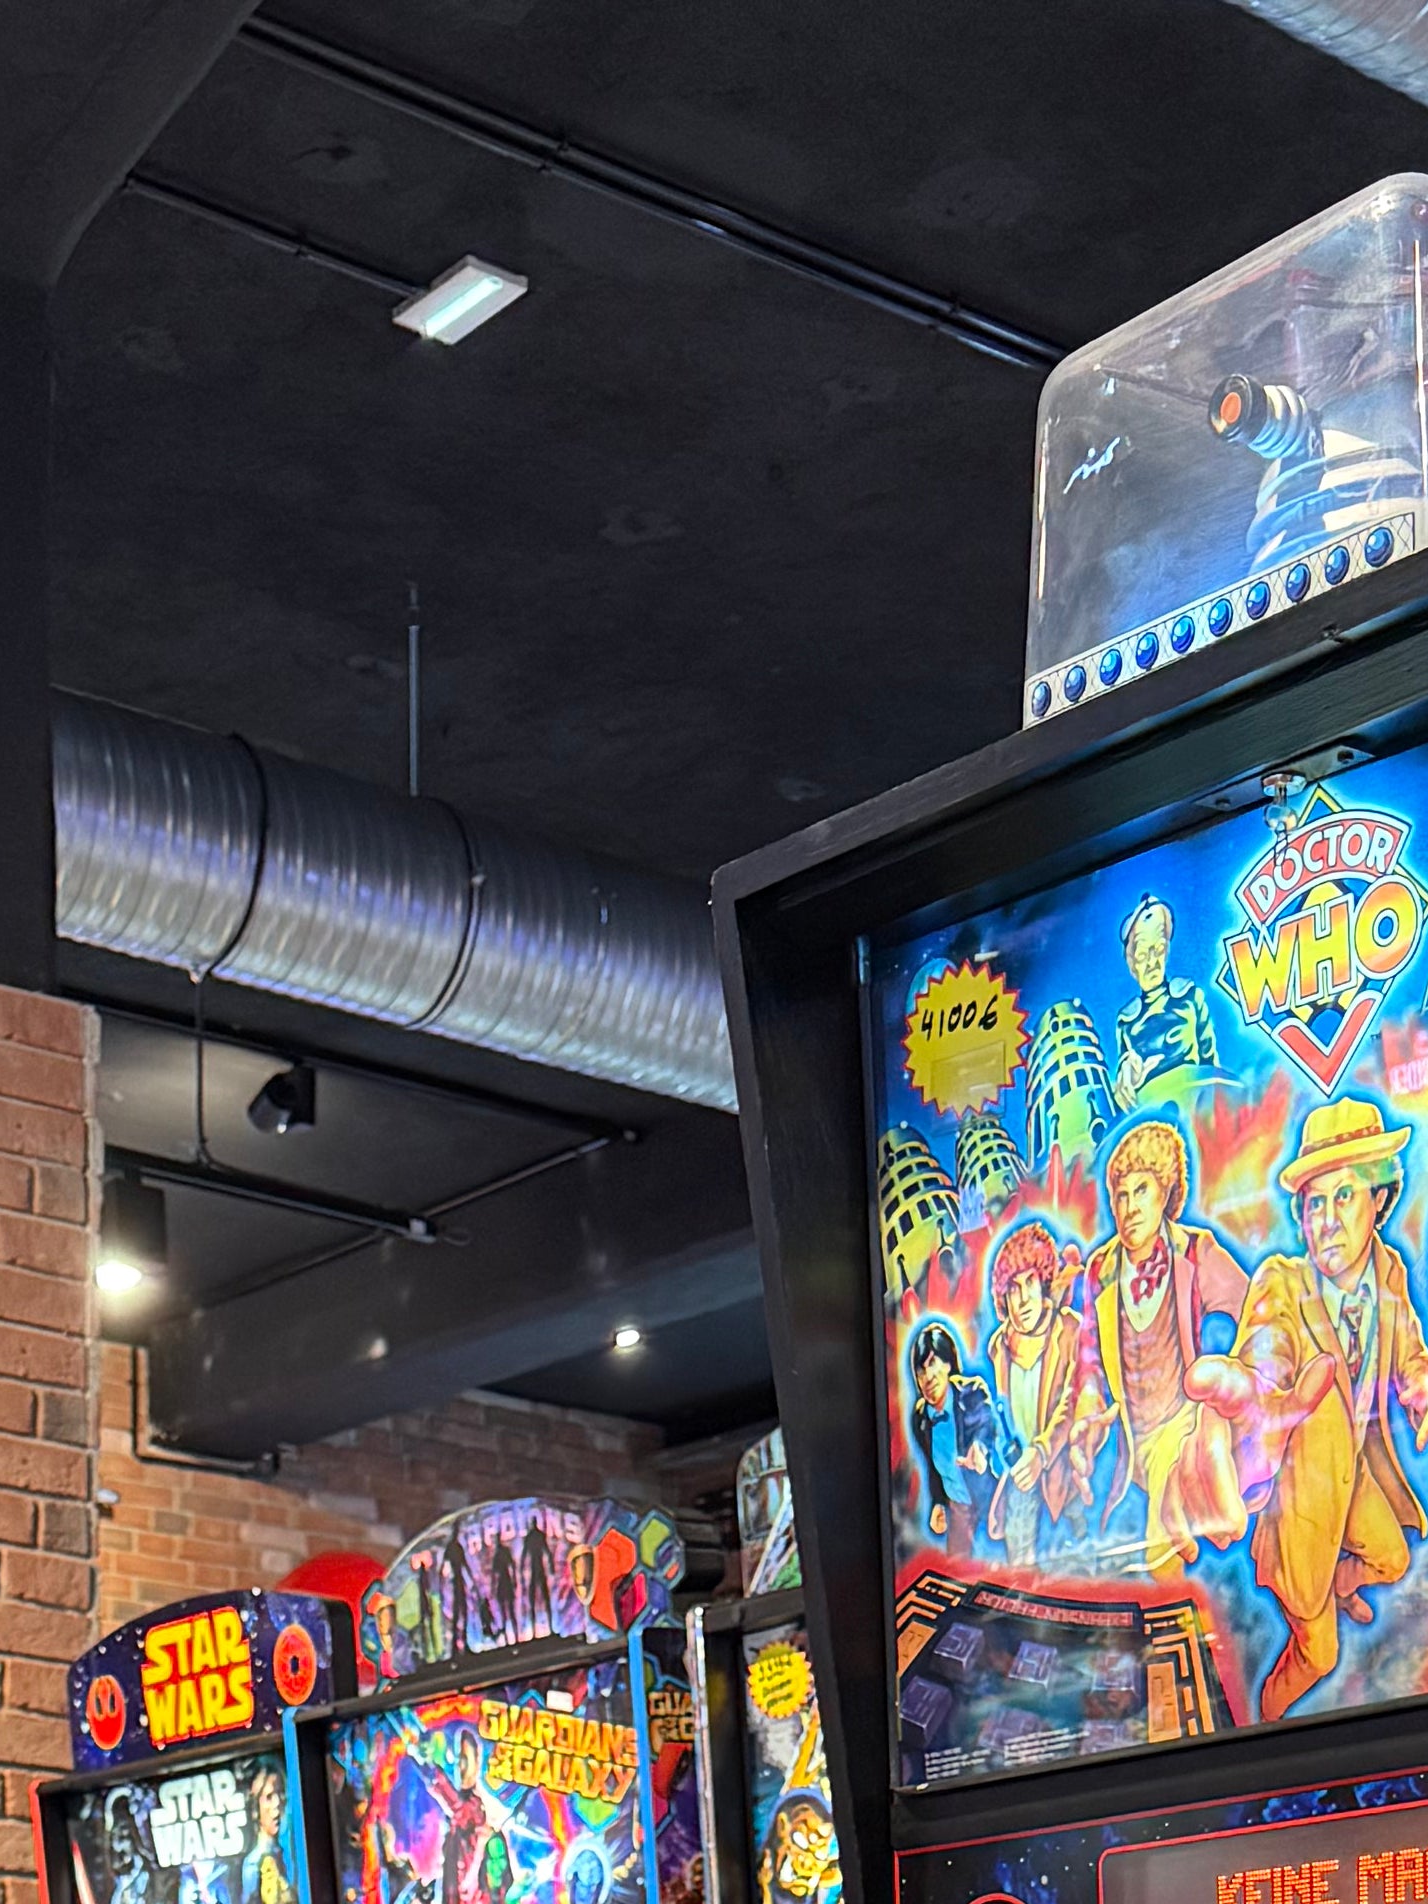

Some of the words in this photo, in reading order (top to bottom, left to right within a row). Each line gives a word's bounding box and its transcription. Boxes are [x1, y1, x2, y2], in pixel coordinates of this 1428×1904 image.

[1248, 821, 1395, 914] DOCTOR
[1227, 876, 1421, 1021] WHO
[142, 1608, 250, 1686] STAR
[145, 1664, 254, 1744] WARS
[477, 1699, 639, 1768] GUARDIANS
[150, 1769, 246, 1828] STAR
[512, 1744, 636, 1804] GALAXY
[151, 1809, 247, 1868] WARS
